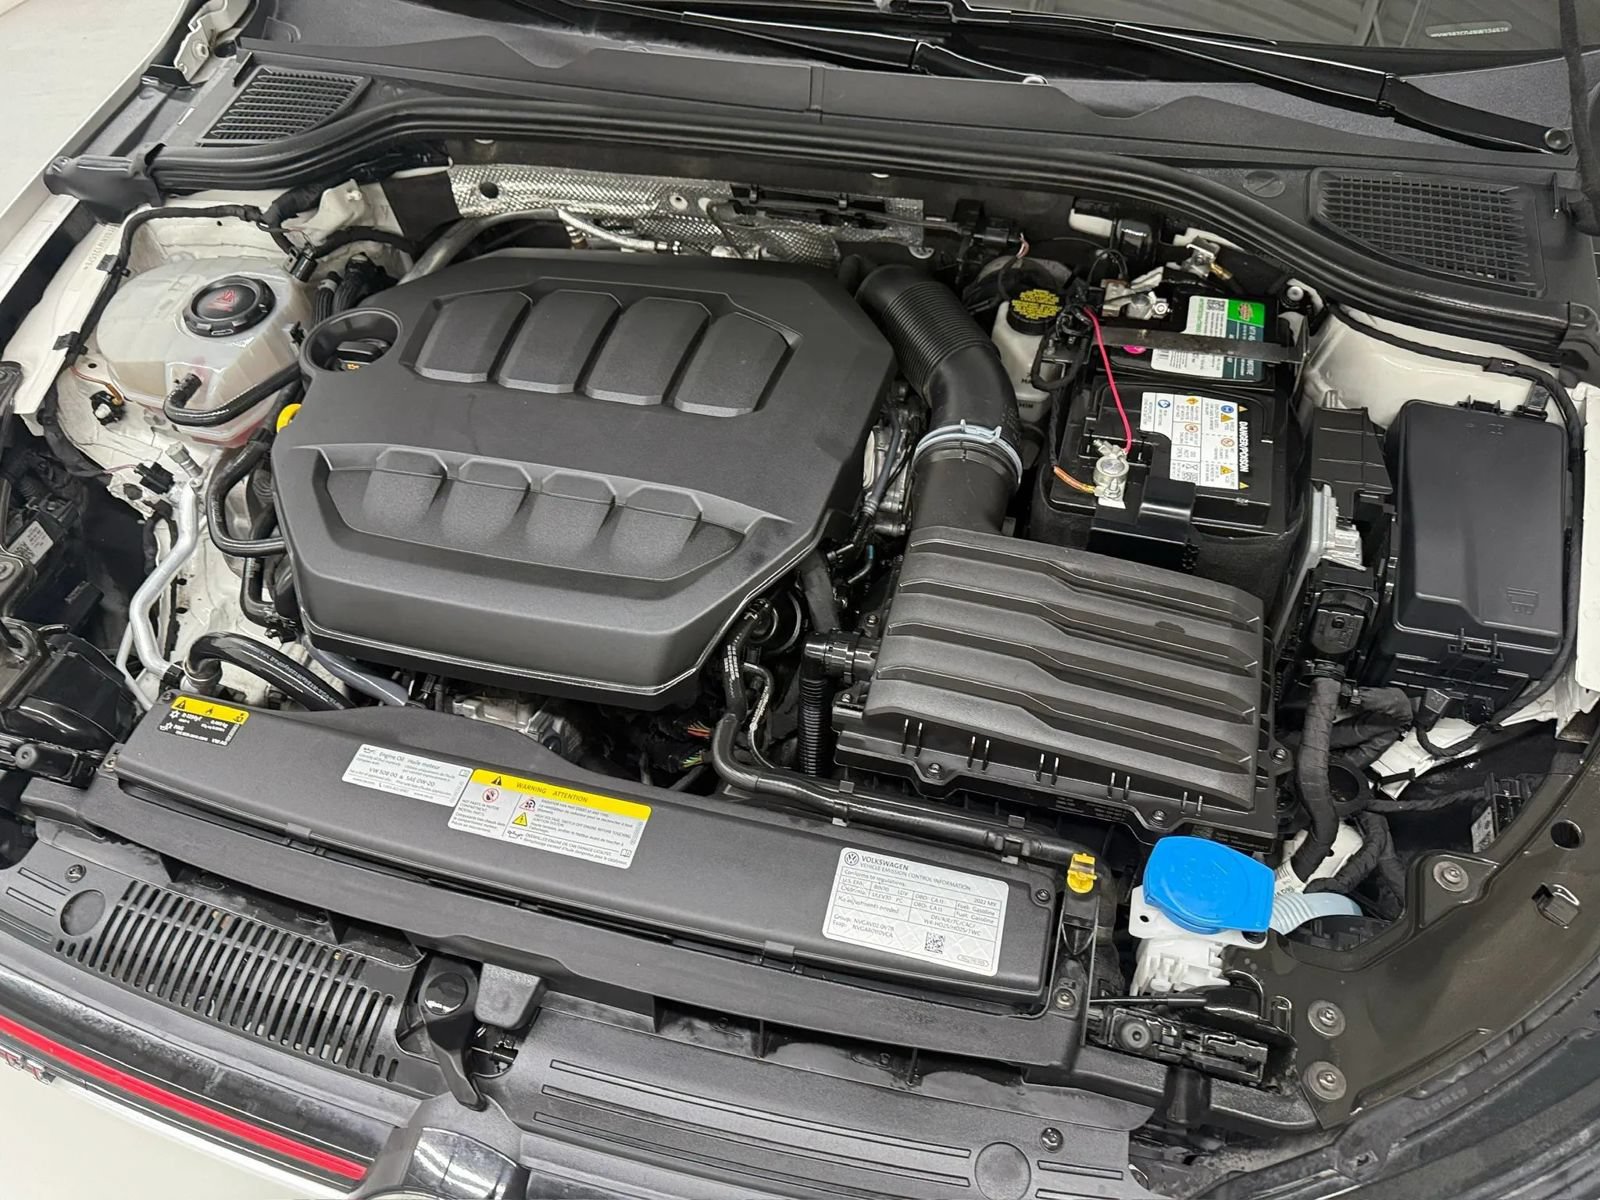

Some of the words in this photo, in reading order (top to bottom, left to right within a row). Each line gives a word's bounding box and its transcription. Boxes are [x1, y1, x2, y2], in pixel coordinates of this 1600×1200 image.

[1238, 421, 1249, 473] DANGER/POISON
[517, 783, 546, 794] WARNING
[552, 791, 587, 802] ATTENTION
[862, 856, 908, 870] VOLKSWAGEN
[860, 862, 880, 871] VEHICLE
[882, 867, 907, 876] EMISSION
[908, 873, 932, 882] CONTROL
[934, 879, 970, 890] INFORMATION
[971, 914, 994, 924] Gasoline
[972, 906, 995, 916] Gasoline
